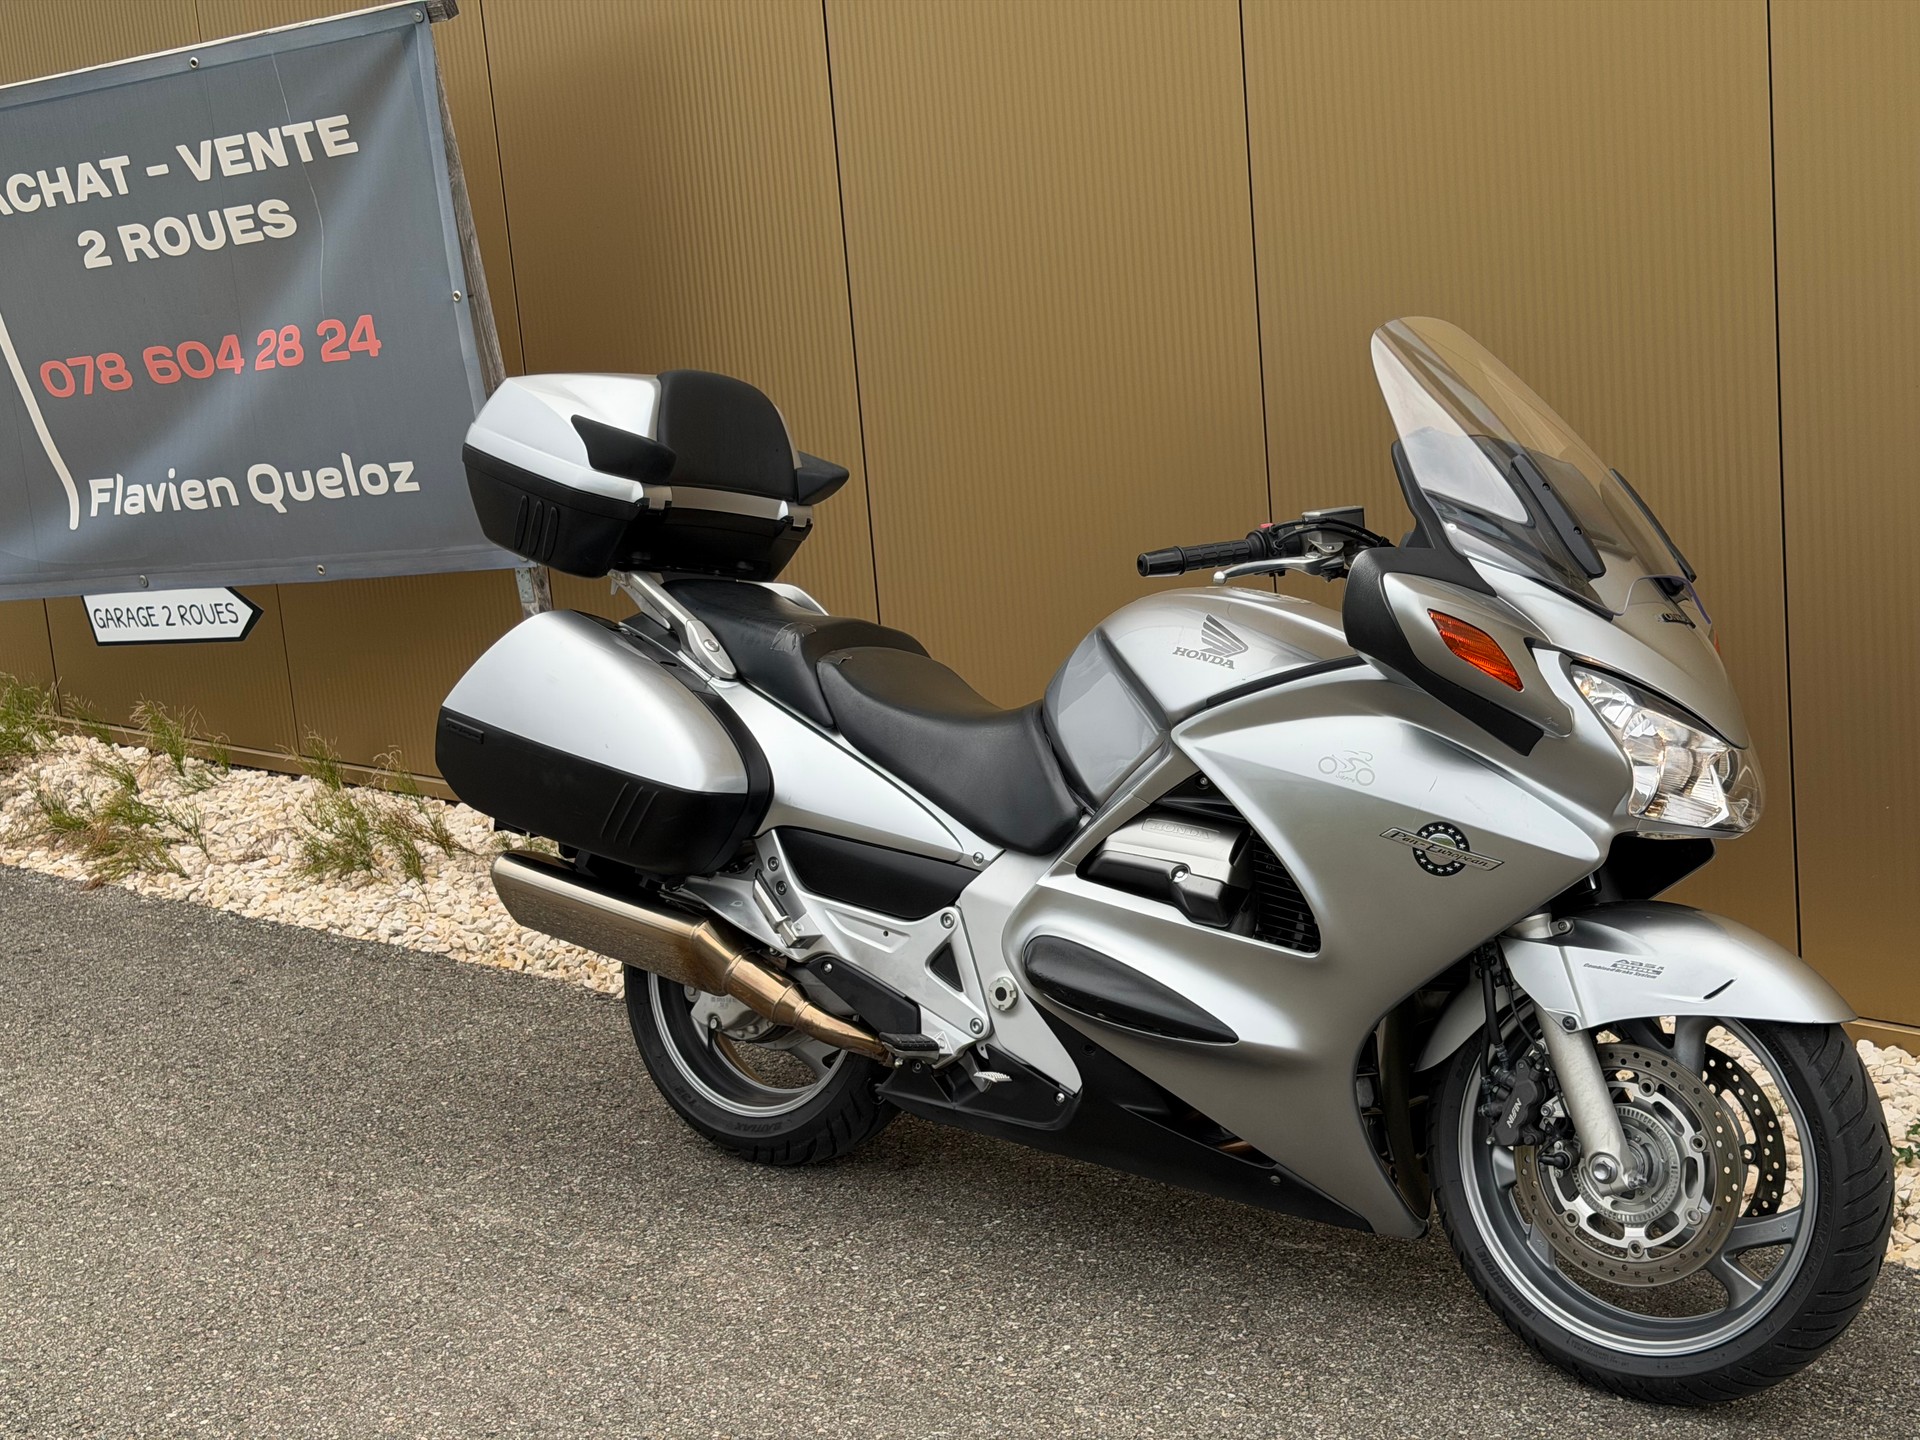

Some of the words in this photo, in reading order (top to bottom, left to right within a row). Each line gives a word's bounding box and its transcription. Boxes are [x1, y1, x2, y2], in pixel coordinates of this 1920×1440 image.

[175, 114, 359, 182] VENTE
[77, 229, 113, 269] 2
[116, 198, 298, 263] ROUES
[39, 352, 133, 398] 078
[143, 334, 245, 385] 604
[255, 324, 305, 371] 28
[316, 314, 382, 363] 24
[88, 467, 240, 518] Flavien
[246, 452, 421, 514] Queloz
[93, 606, 159, 629] GARAGE
[161, 605, 177, 627] 2
[177, 602, 239, 626] ROUES
[1172, 646, 1235, 670] HONDA
[1150, 821, 1210, 839] HONDA
[1476, 1250, 1536, 1318] BRIDGESTONE
